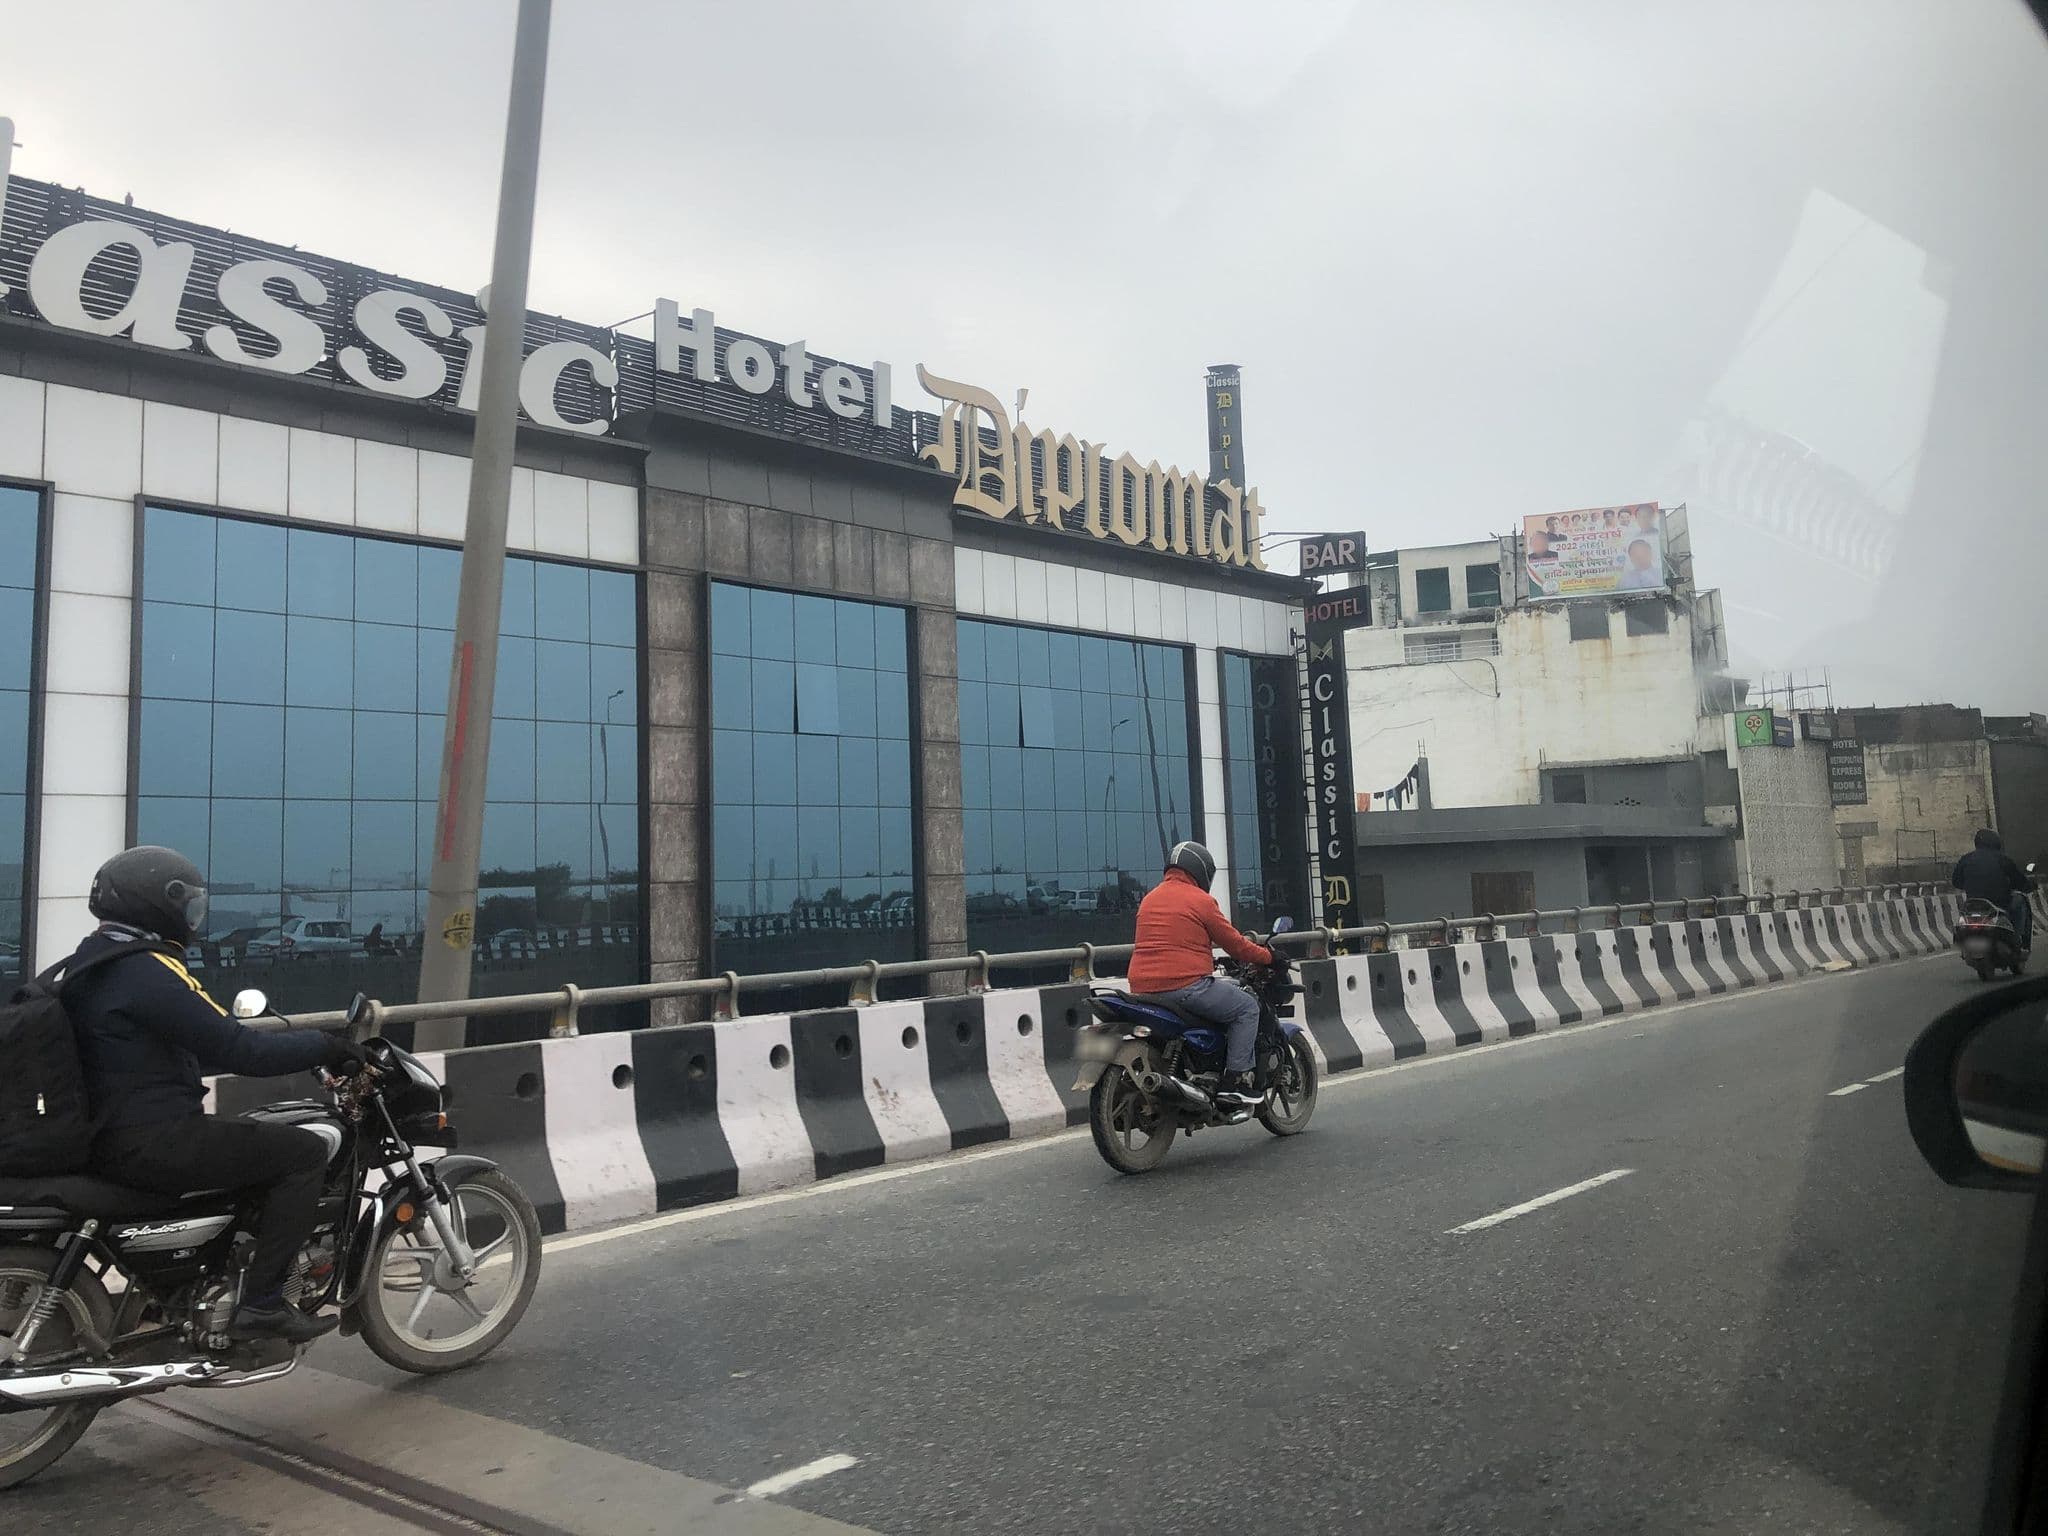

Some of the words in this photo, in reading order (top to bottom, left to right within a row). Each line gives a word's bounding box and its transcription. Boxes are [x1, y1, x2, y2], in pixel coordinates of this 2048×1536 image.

[0, 116, 618, 436] assic
[655, 297, 891, 428] Hotel
[1207, 374, 1240, 388] Classic
[916, 362, 1268, 571] Diplomat
[1302, 539, 1357, 569] BAR
[1556, 542, 1577, 550] 2022
[1304, 598, 1363, 622] HOTEL
[1832, 739, 1858, 748] HOTEL
[1314, 673, 1342, 860] Classic
[1831, 766, 1862, 775] EXPRESS
